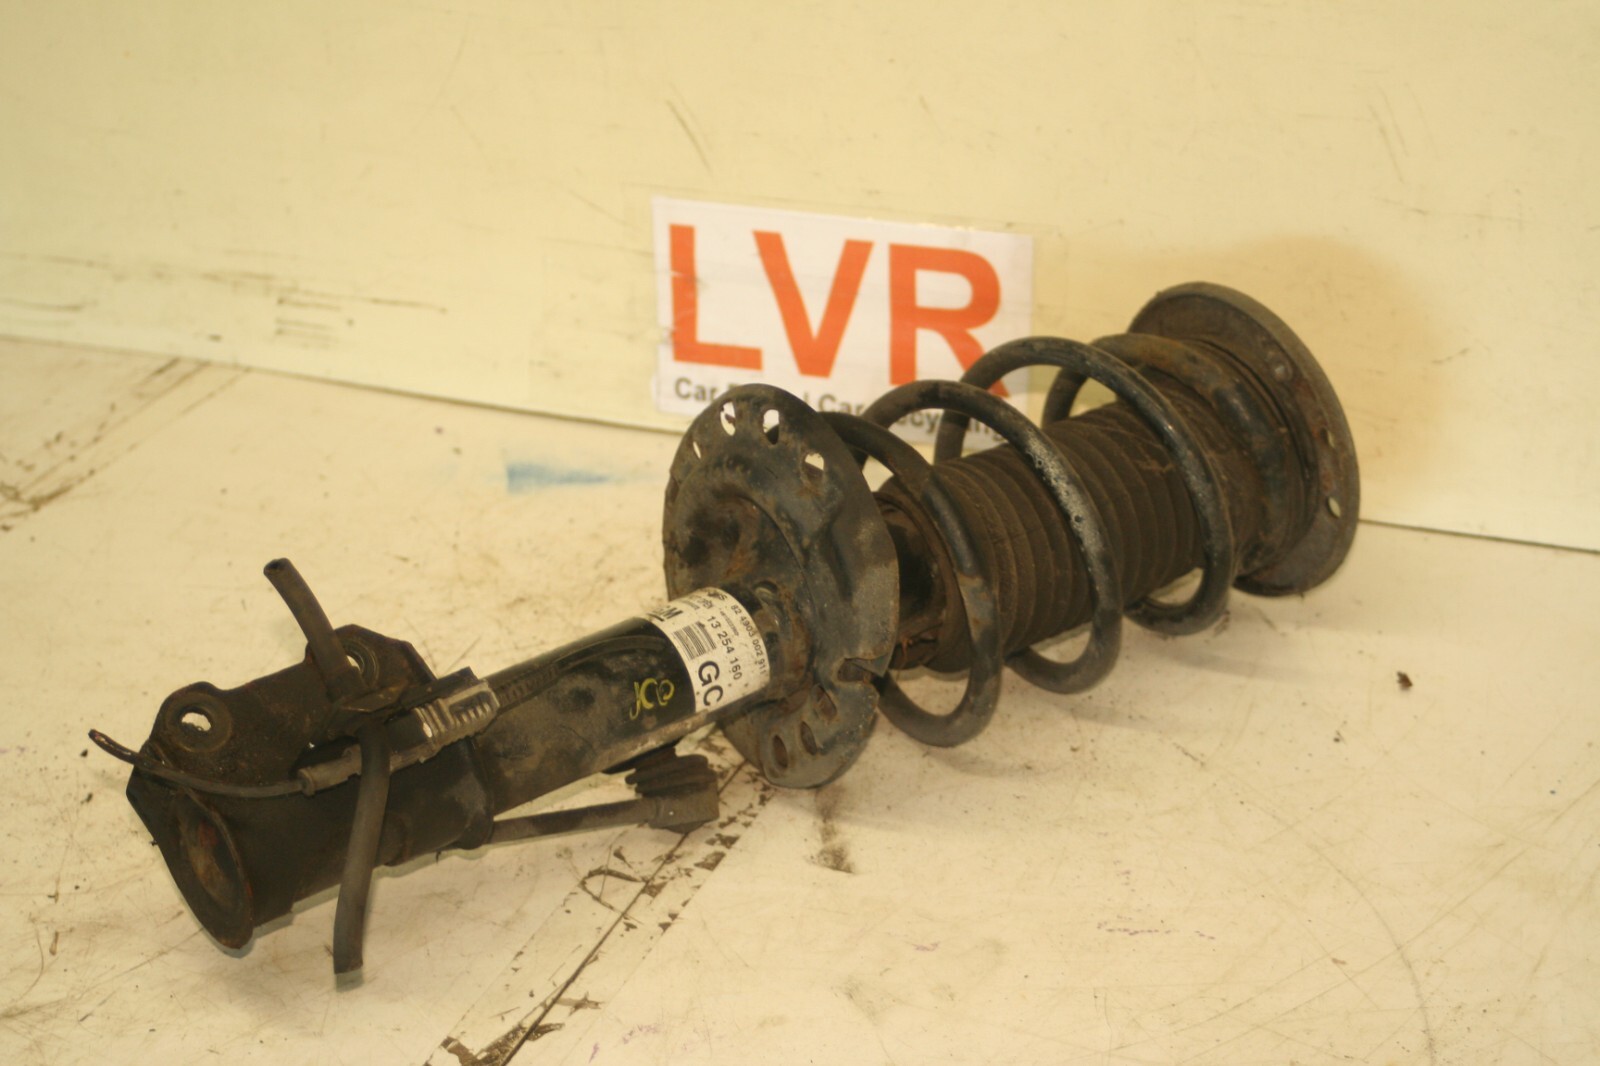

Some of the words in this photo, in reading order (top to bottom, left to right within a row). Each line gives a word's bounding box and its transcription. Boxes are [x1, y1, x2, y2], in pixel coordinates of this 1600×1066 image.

[669, 224, 1008, 398] LVR
[674, 377, 717, 401] Car
[707, 615, 721, 630] 13
[717, 630, 735, 654] 254
[729, 656, 742, 680] 160
[698, 660, 724, 706] GC
